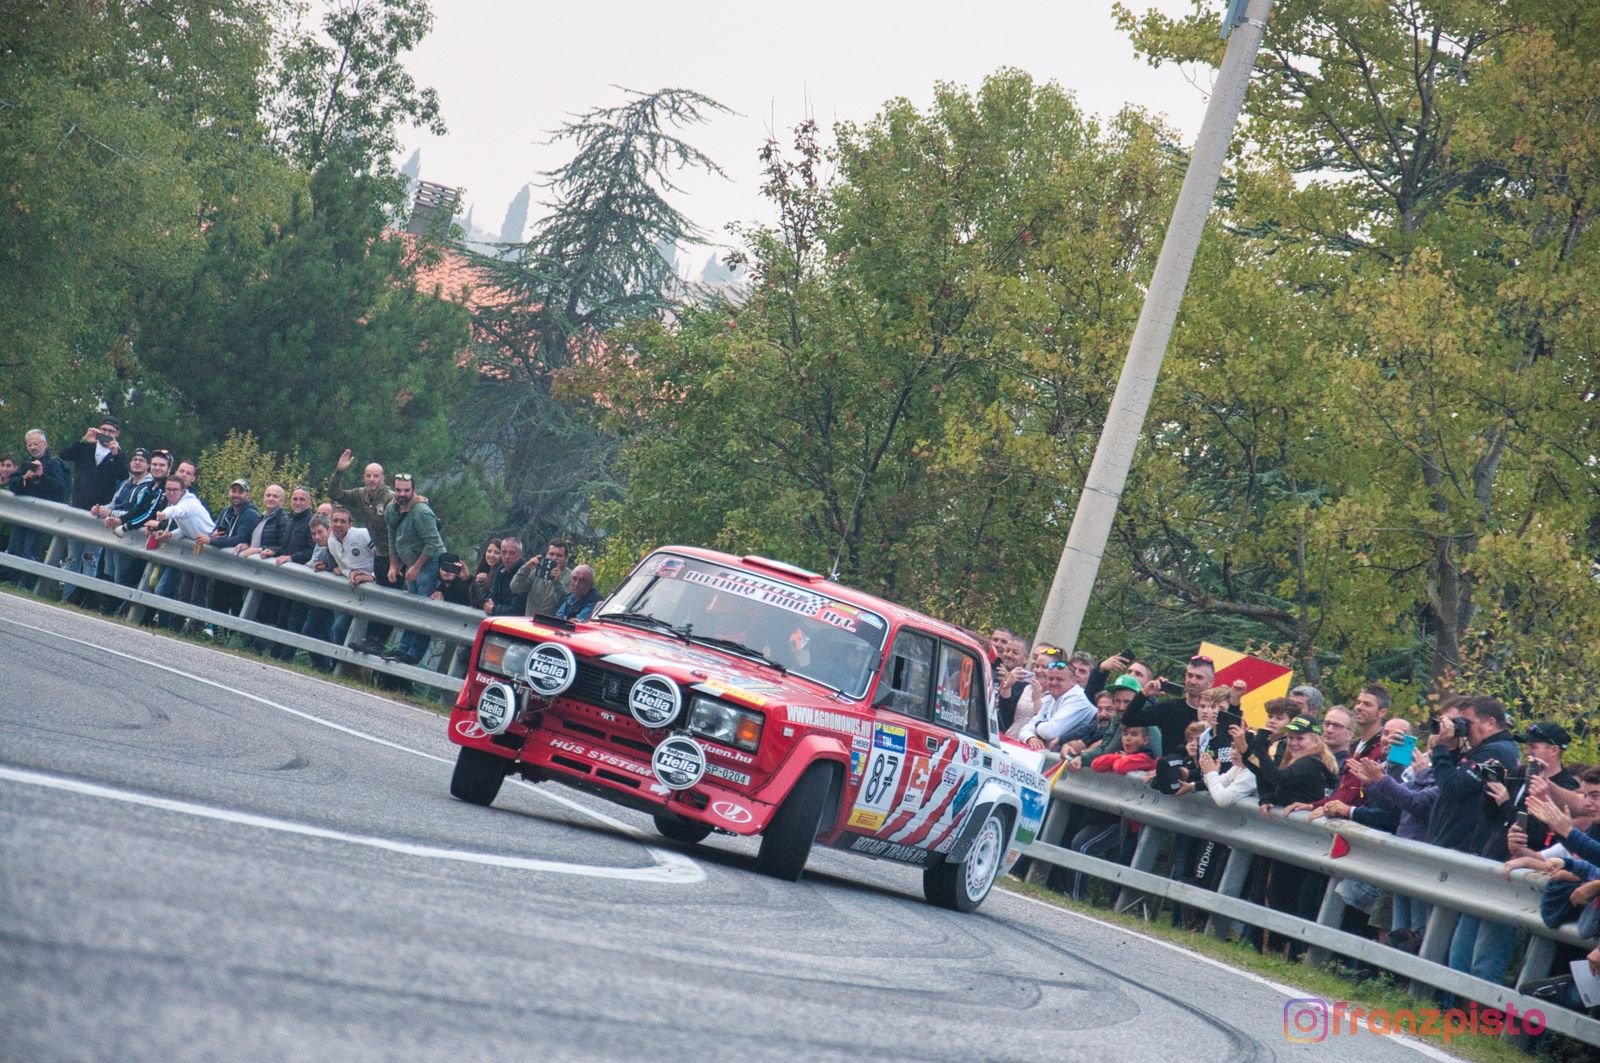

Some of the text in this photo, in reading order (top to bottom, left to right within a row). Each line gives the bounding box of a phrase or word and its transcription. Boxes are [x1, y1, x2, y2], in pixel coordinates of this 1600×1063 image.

[531, 660, 565, 678] Hella
[476, 672, 500, 686] lad
[481, 700, 505, 717] Hella
[636, 692, 671, 712] Hella
[549, 738, 585, 756] HÚS
[587, 750, 655, 778] SYSTEM
[659, 755, 698, 773] Hella
[704, 762, 747, 784] SP-0204
[865, 753, 899, 805] 87
